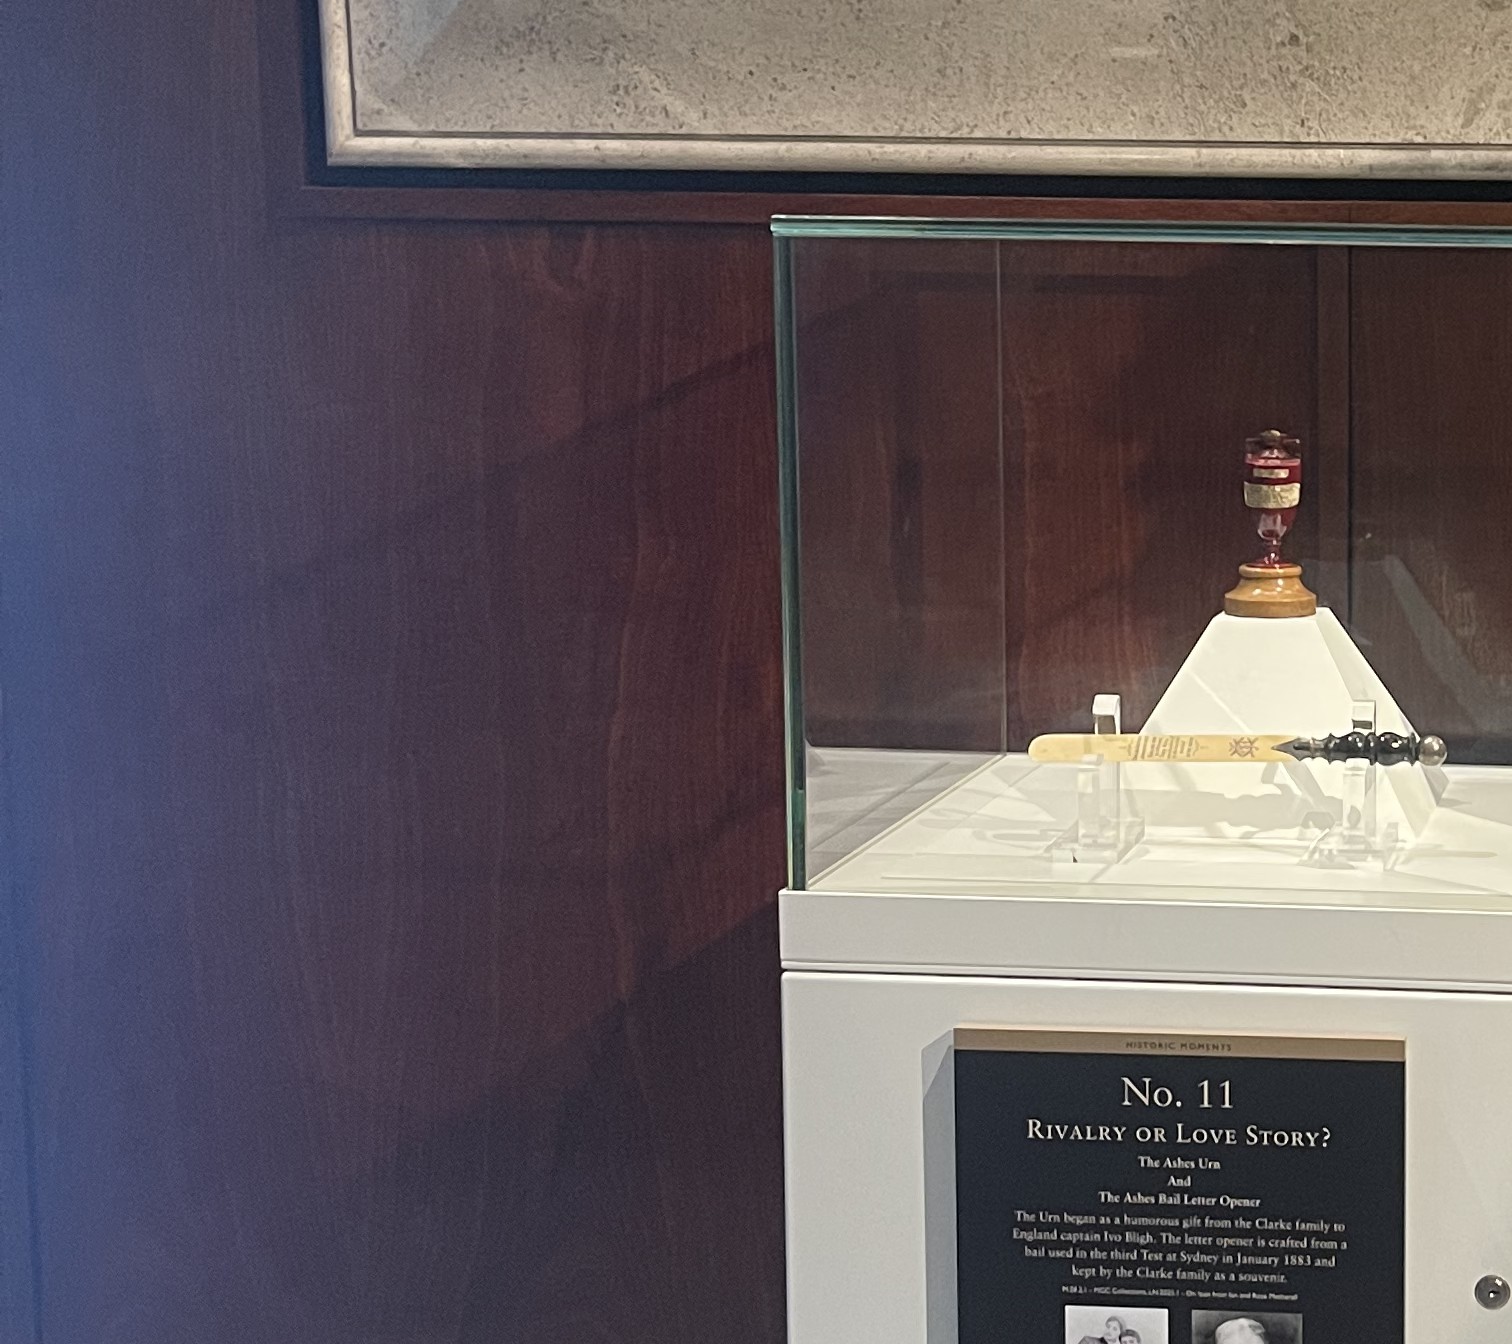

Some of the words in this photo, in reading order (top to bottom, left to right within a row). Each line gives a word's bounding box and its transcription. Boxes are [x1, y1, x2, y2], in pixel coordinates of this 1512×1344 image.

[1125, 1041, 1177, 1051] HISTORIC
[1180, 1042, 1233, 1052] MOMENTS
[1121, 1076, 1183, 1108] No.
[1197, 1079, 1235, 1109] 11
[1138, 1155, 1161, 1168] The
[1164, 1156, 1196, 1169] Ashes
[1198, 1157, 1221, 1170] Urn
[1167, 1175, 1192, 1187] And
[1098, 1190, 1121, 1203] The
[1124, 1192, 1156, 1205] Ashes
[1158, 1193, 1181, 1206] Bail
[1184, 1193, 1217, 1206] Letter
[1219, 1194, 1262, 1210] Opener
[1014, 1210, 1037, 1223] The
[1039, 1211, 1061, 1224] Urn
[1063, 1212, 1096, 1226] began
[1099, 1215, 1112, 1225] as
[1114, 1217, 1121, 1225] a
[1123, 1213, 1180, 1227] humorous
[1182, 1216, 1202, 1229] gift
[1204, 1215, 1232, 1229] from
[1234, 1217, 1253, 1229] the
[1255, 1217, 1293, 1231] Clarke
[1295, 1218, 1331, 1234] family
[1333, 1222, 1346, 1233] to
[1012, 1227, 1058, 1242] England
[1060, 1230, 1101, 1244] captain
[1103, 1231, 1123, 1242] Ivo
[1160, 1232, 1182, 1244] The
[1184, 1233, 1213, 1246] letter
[1216, 1237, 1254, 1249] opener
[1257, 1236, 1266, 1247] is
[1268, 1236, 1308, 1249] crafted
[1310, 1237, 1338, 1250] from
[1340, 1241, 1348, 1250] a
[1024, 1245, 1046, 1257] bail
[1048, 1247, 1074, 1259] used
[1075, 1247, 1087, 1259] in
[1090, 1248, 1108, 1260] the
[1110, 1249, 1138, 1261] third
[1140, 1249, 1163, 1262] Test
[1166, 1252, 1178, 1262] at
[1180, 1250, 1218, 1265] Sydney
[1222, 1251, 1233, 1263] in
[1235, 1252, 1280, 1267] January
[1284, 1254, 1312, 1266] 1883
[1314, 1255, 1336, 1267] and
[1071, 1264, 1096, 1279] kept
[1100, 1265, 1113, 1280] by
[1115, 1266, 1134, 1278] the
[1136, 1266, 1174, 1279] Clarke
[1176, 1268, 1211, 1283] family
[1214, 1271, 1226, 1281] as
[1229, 1272, 1236, 1281] a
[1238, 1271, 1289, 1283] souvenir.
